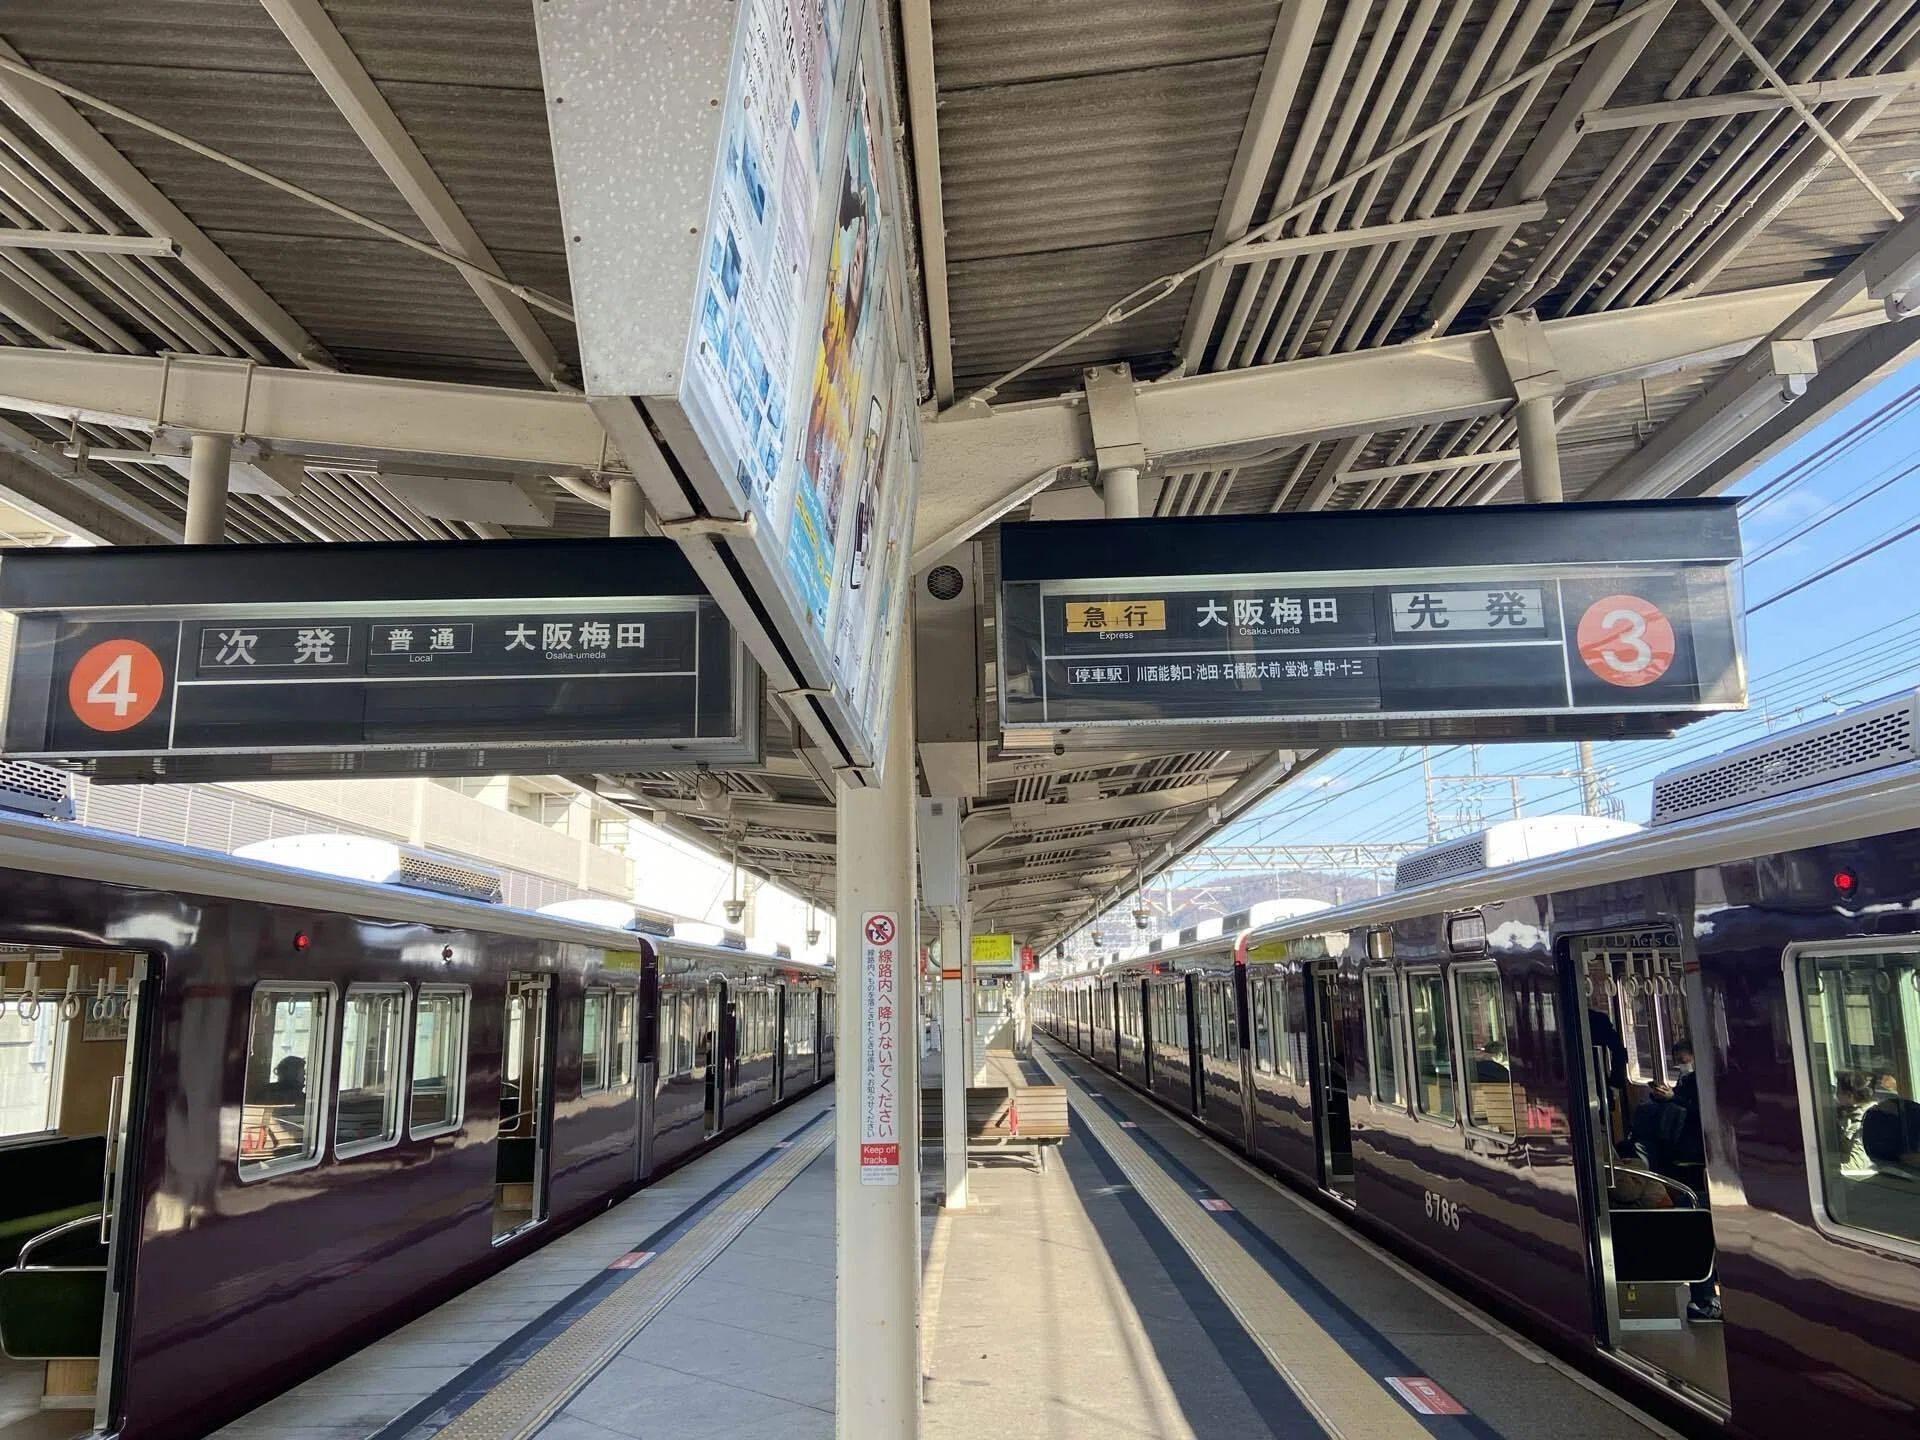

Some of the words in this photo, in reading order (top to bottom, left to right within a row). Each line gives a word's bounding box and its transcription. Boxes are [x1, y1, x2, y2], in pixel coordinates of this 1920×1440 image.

[1083, 605, 1148, 628] 急行
[1196, 597, 1338, 628] 大阪梅田
[1408, 592, 1527, 630] 先発
[215, 628, 336, 665] 次発
[387, 628, 455, 651] 普通
[504, 621, 646, 651] 大阪梅田
[1099, 630, 1135, 640] Express
[1239, 627, 1300, 636] Osaka-umeda
[1601, 609, 1652, 672] 3
[409, 654, 433, 663] Local
[545, 650, 606, 660] Osaka-umeda
[86, 654, 137, 716] 4
[1075, 668, 1122, 682] 停車駅
[1614, 934, 1661, 948] Dners
[878, 949, 893, 1138] 線路内へ降りないでください
[864, 1145, 884, 1155] Keep
[886, 1145, 896, 1154] off
[864, 1156, 888, 1164] tracks
[1425, 1190, 1460, 1231] 8786
